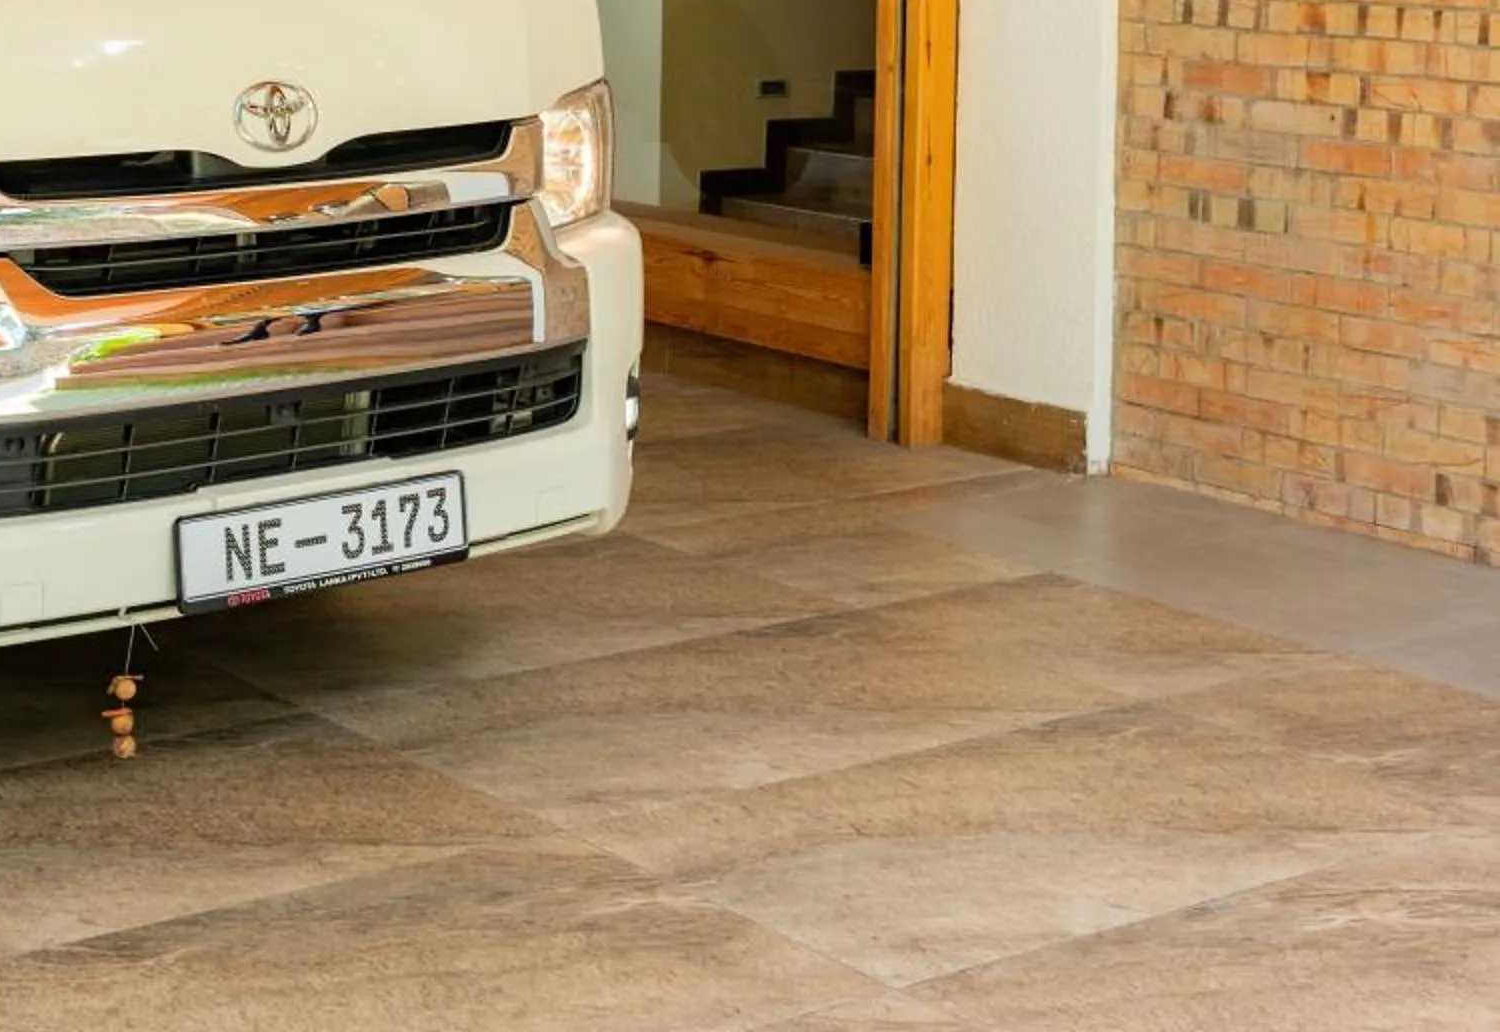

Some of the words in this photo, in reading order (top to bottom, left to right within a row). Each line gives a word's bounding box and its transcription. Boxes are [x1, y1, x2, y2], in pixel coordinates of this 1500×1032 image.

[283, 580, 317, 594] TOYOTA
[319, 575, 348, 587] LANKA
[240, 589, 271, 604] TOYOTA
